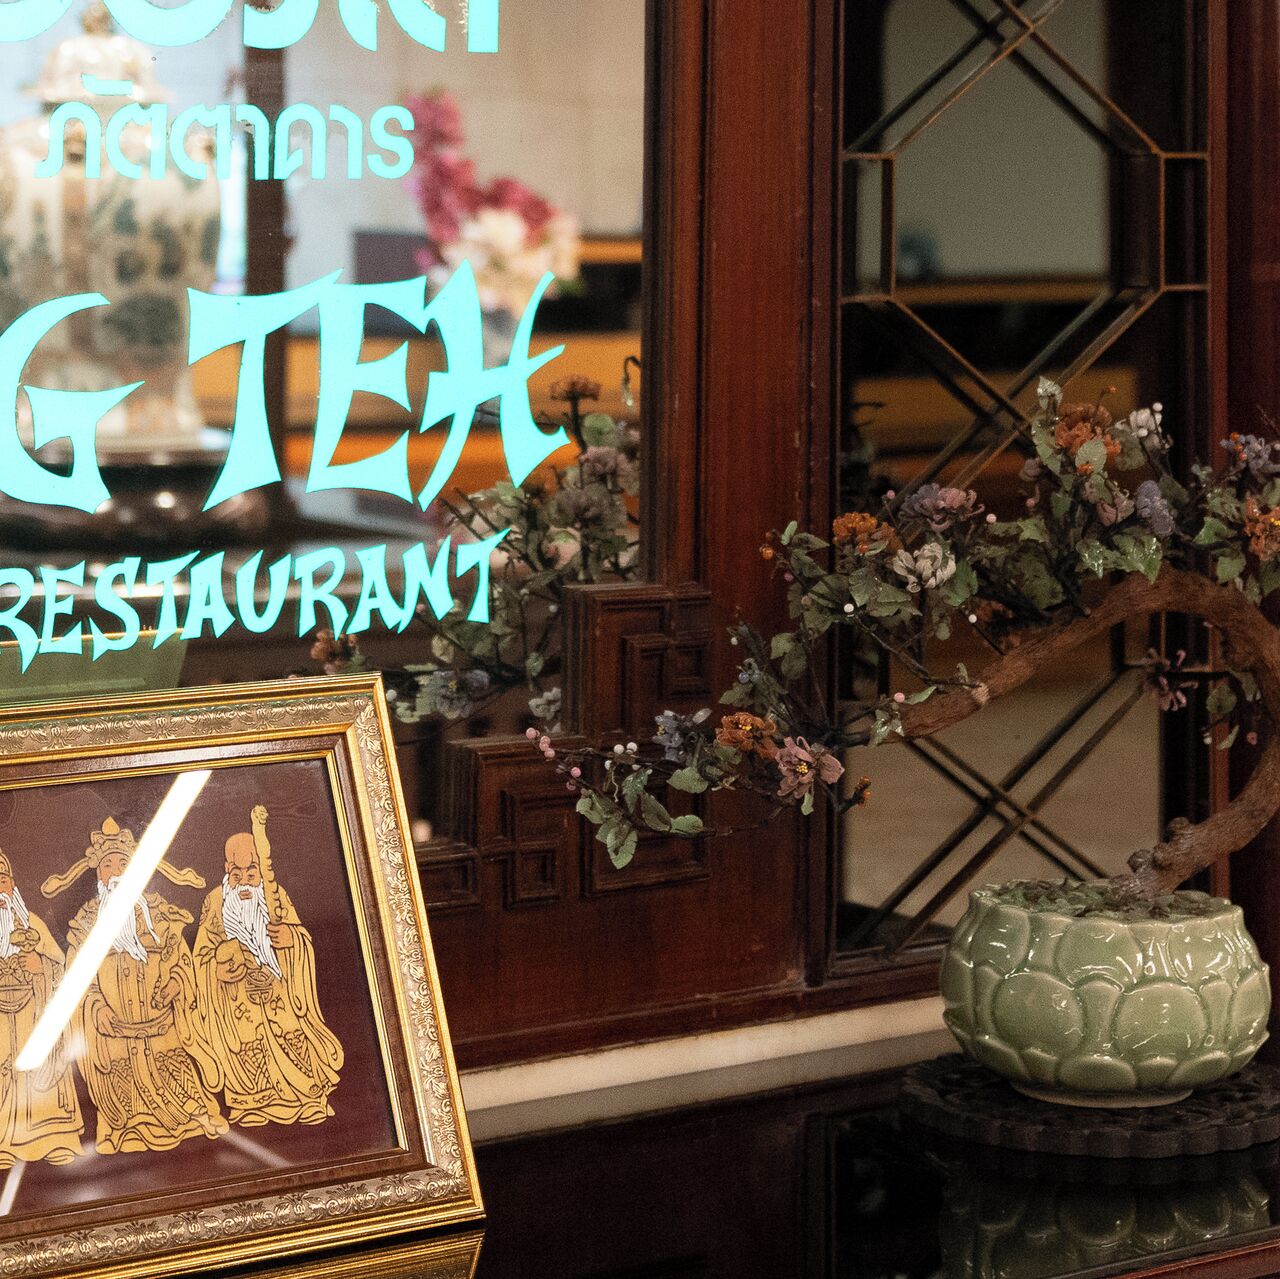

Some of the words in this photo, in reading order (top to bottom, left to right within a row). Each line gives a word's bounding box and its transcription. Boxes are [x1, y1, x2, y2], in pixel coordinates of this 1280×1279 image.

[34, 74, 415, 181] ภัตตาคาร
[188, 258, 570, 513] TEH
